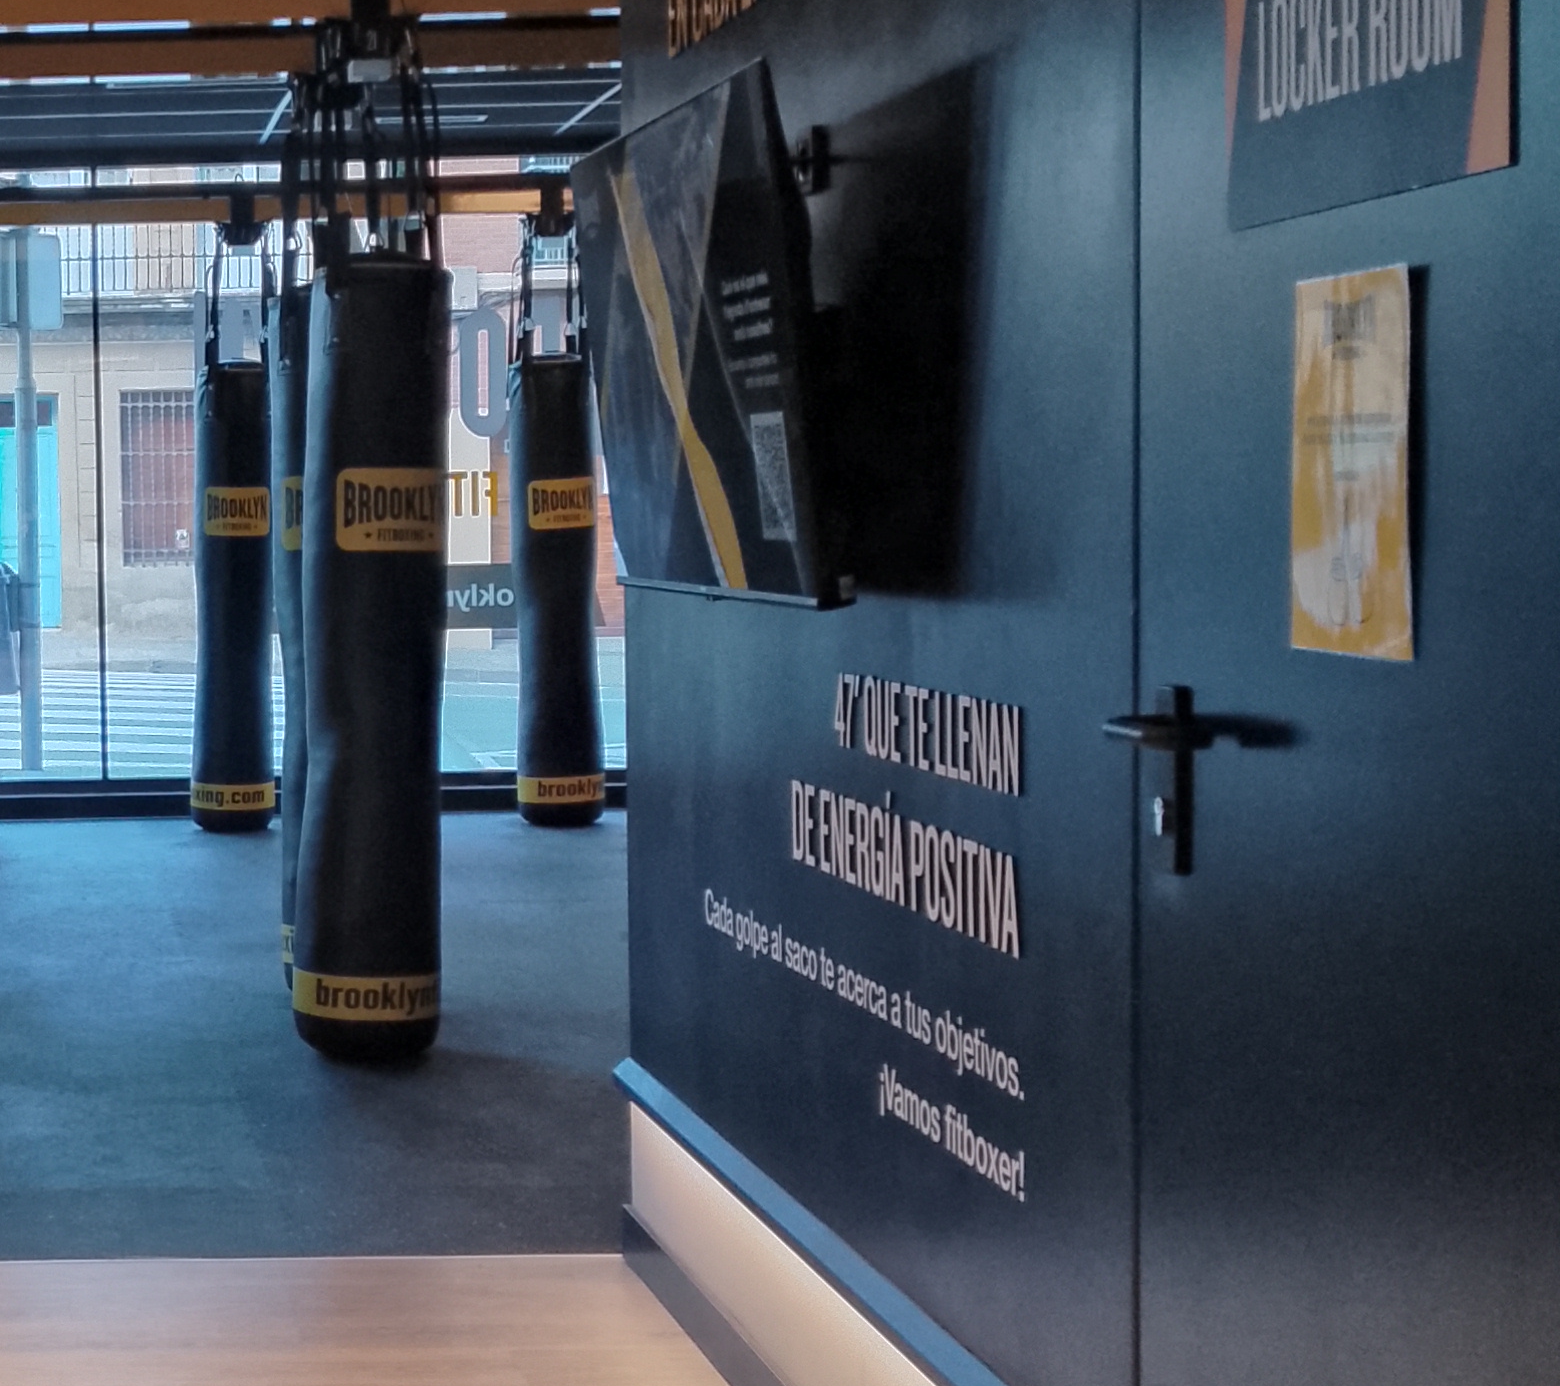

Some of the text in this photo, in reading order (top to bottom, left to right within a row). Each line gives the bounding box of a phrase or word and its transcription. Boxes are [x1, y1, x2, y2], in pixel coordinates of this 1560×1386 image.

[207, 493, 268, 521] BROOKLYN
[377, 528, 425, 542] FITBOXING
[863, 675, 901, 764] QUE
[904, 684, 930, 773] TE
[934, 691, 1020, 797] LLENAN
[791, 779, 1020, 959] DE ENERGÍA POSITIVA
[704, 888, 1025, 1101] Cada golpe al saco te acerca a tus objetivos.
[879, 1063, 1026, 1203] ¡Vamos fitboxer!
